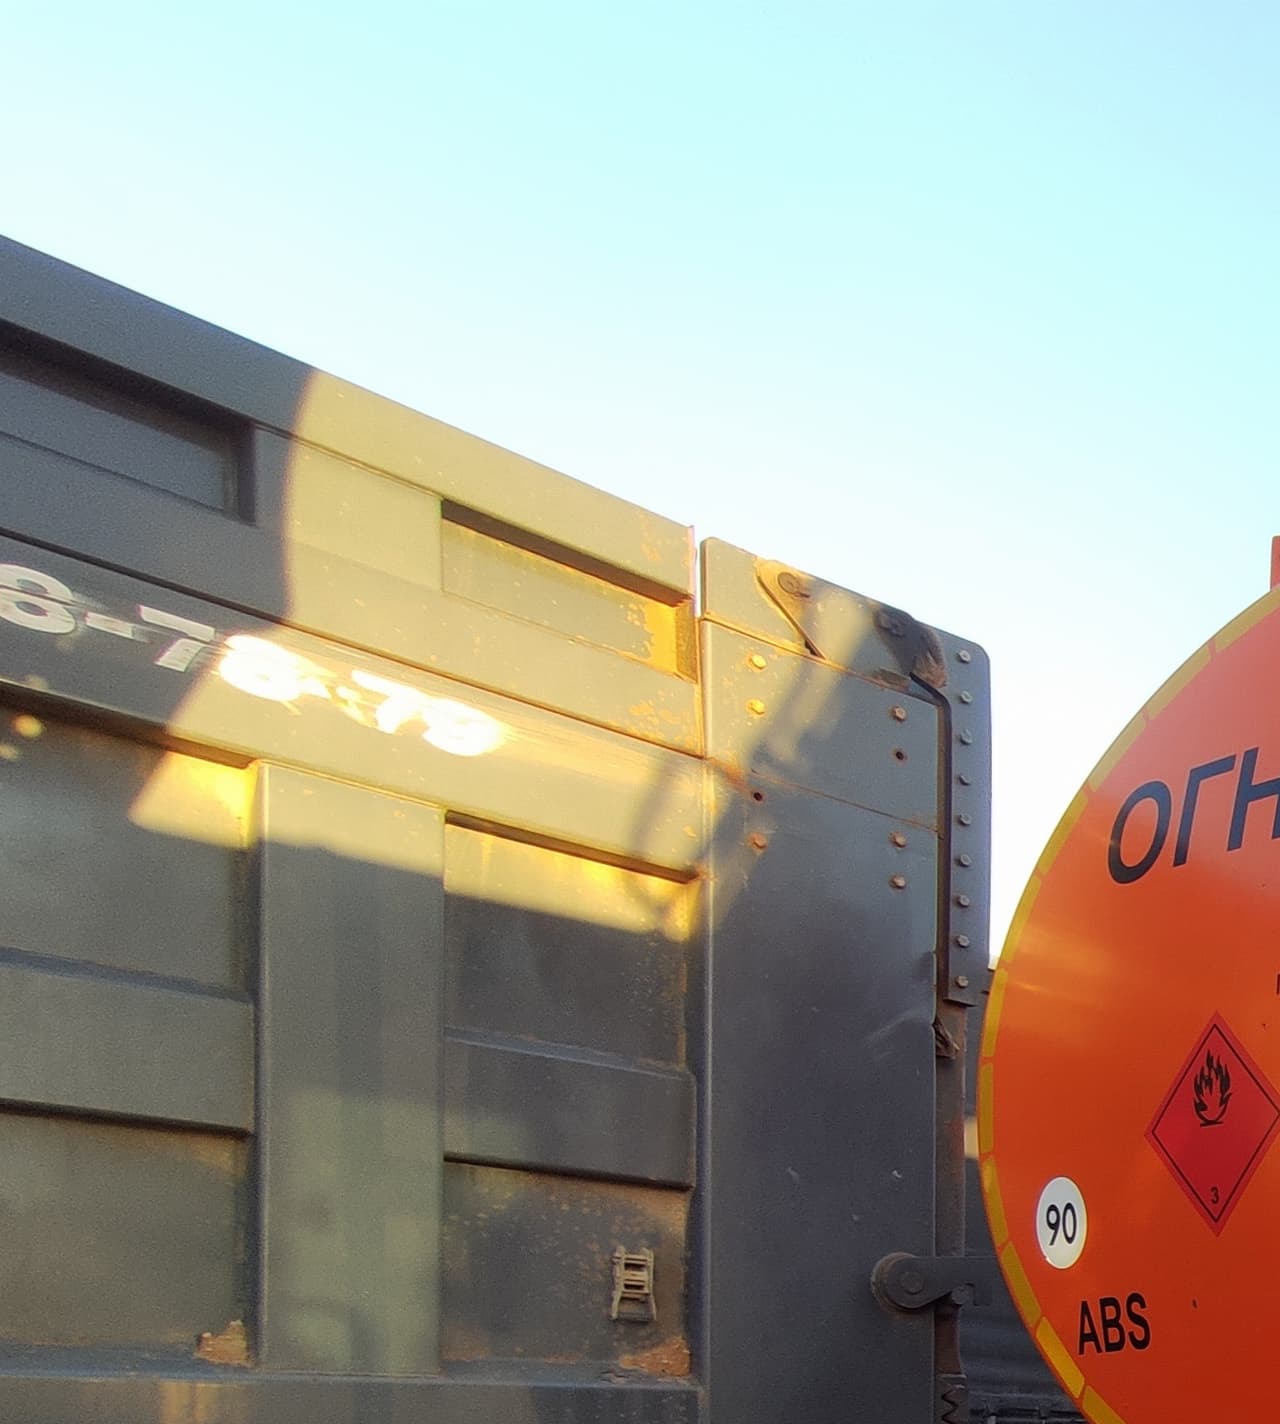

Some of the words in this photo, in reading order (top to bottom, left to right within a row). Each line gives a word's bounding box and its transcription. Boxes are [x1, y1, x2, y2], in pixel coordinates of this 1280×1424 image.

[1210, 1187, 1220, 1205] 3
[1046, 1202, 1077, 1246] 90
[1078, 1292, 1151, 1356] ABS
